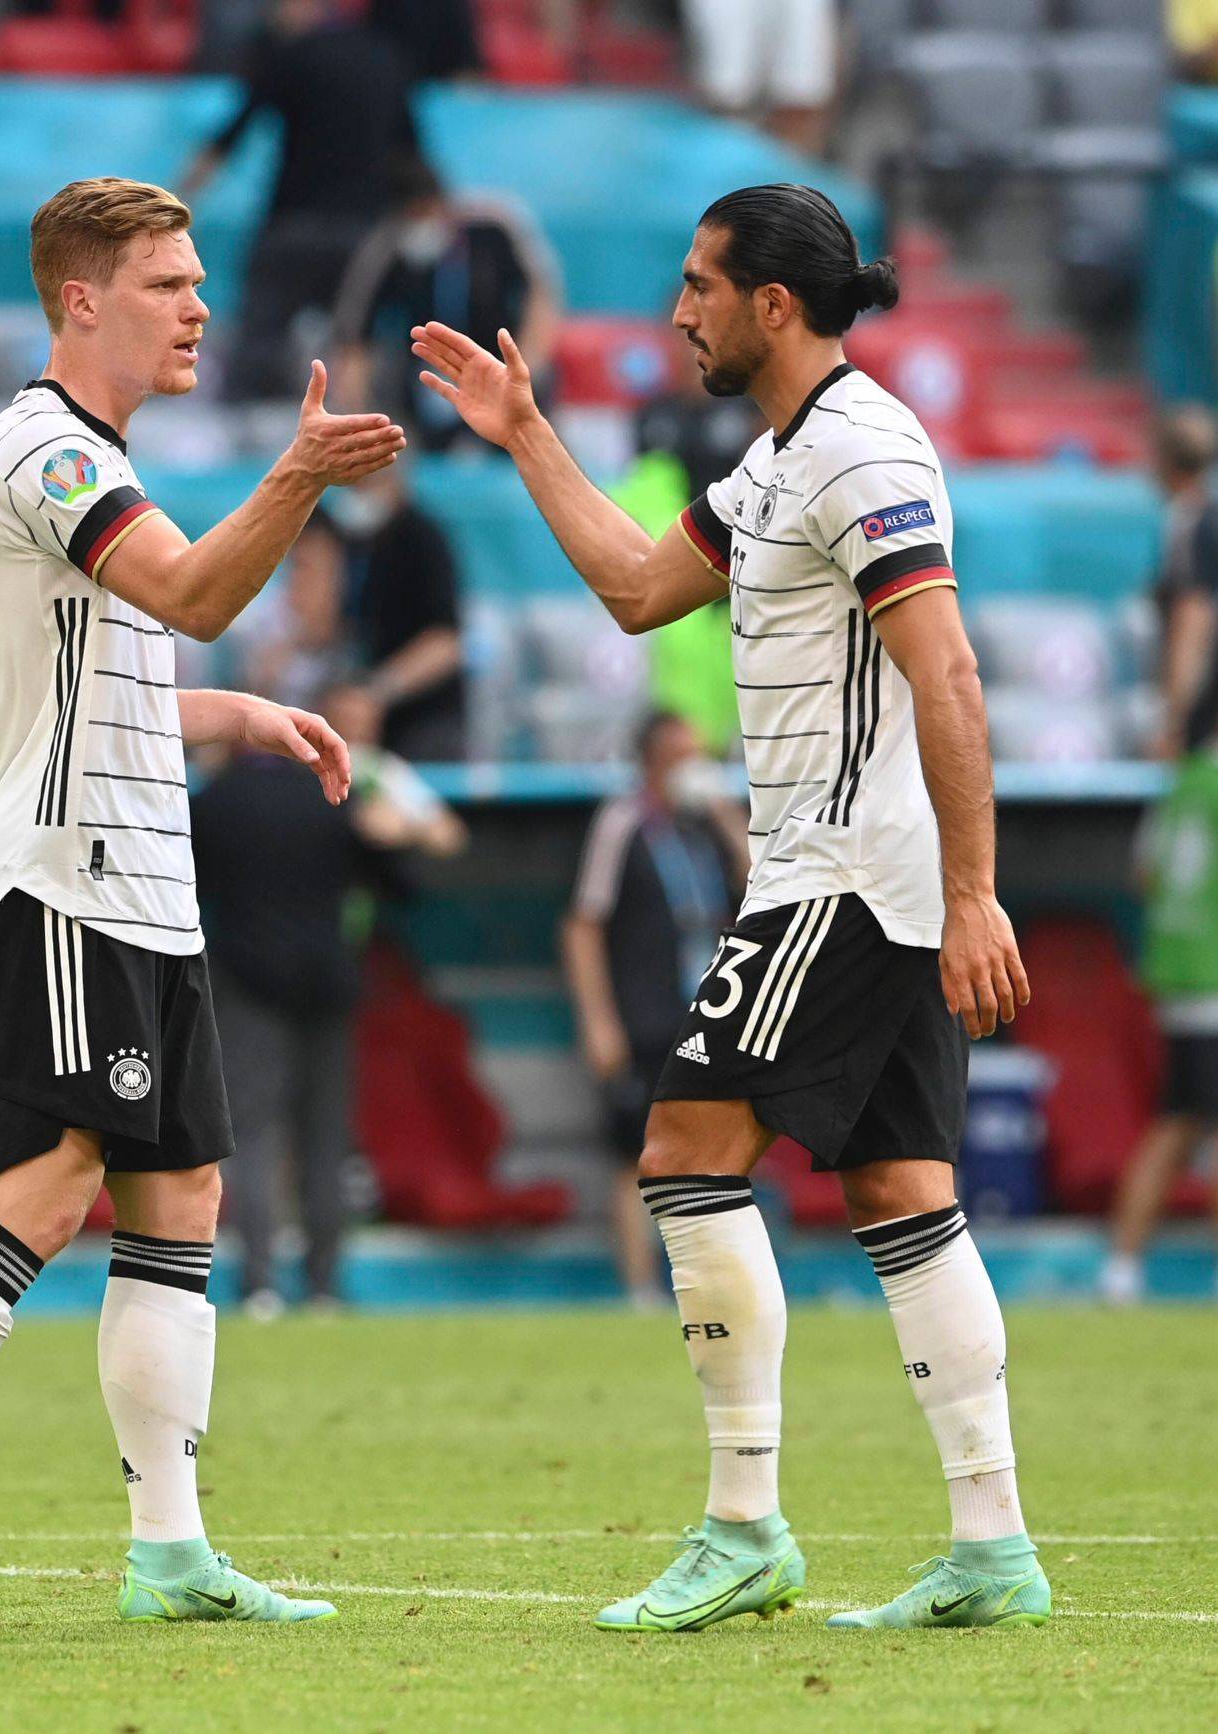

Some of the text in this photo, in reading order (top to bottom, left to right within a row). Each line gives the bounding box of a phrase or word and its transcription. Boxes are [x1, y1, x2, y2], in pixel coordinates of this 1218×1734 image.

[883, 507, 932, 529] RESPECT
[676, 1047, 711, 1065] adidas
[682, 1322, 731, 1342] FB
[903, 1361, 932, 1381] FB
